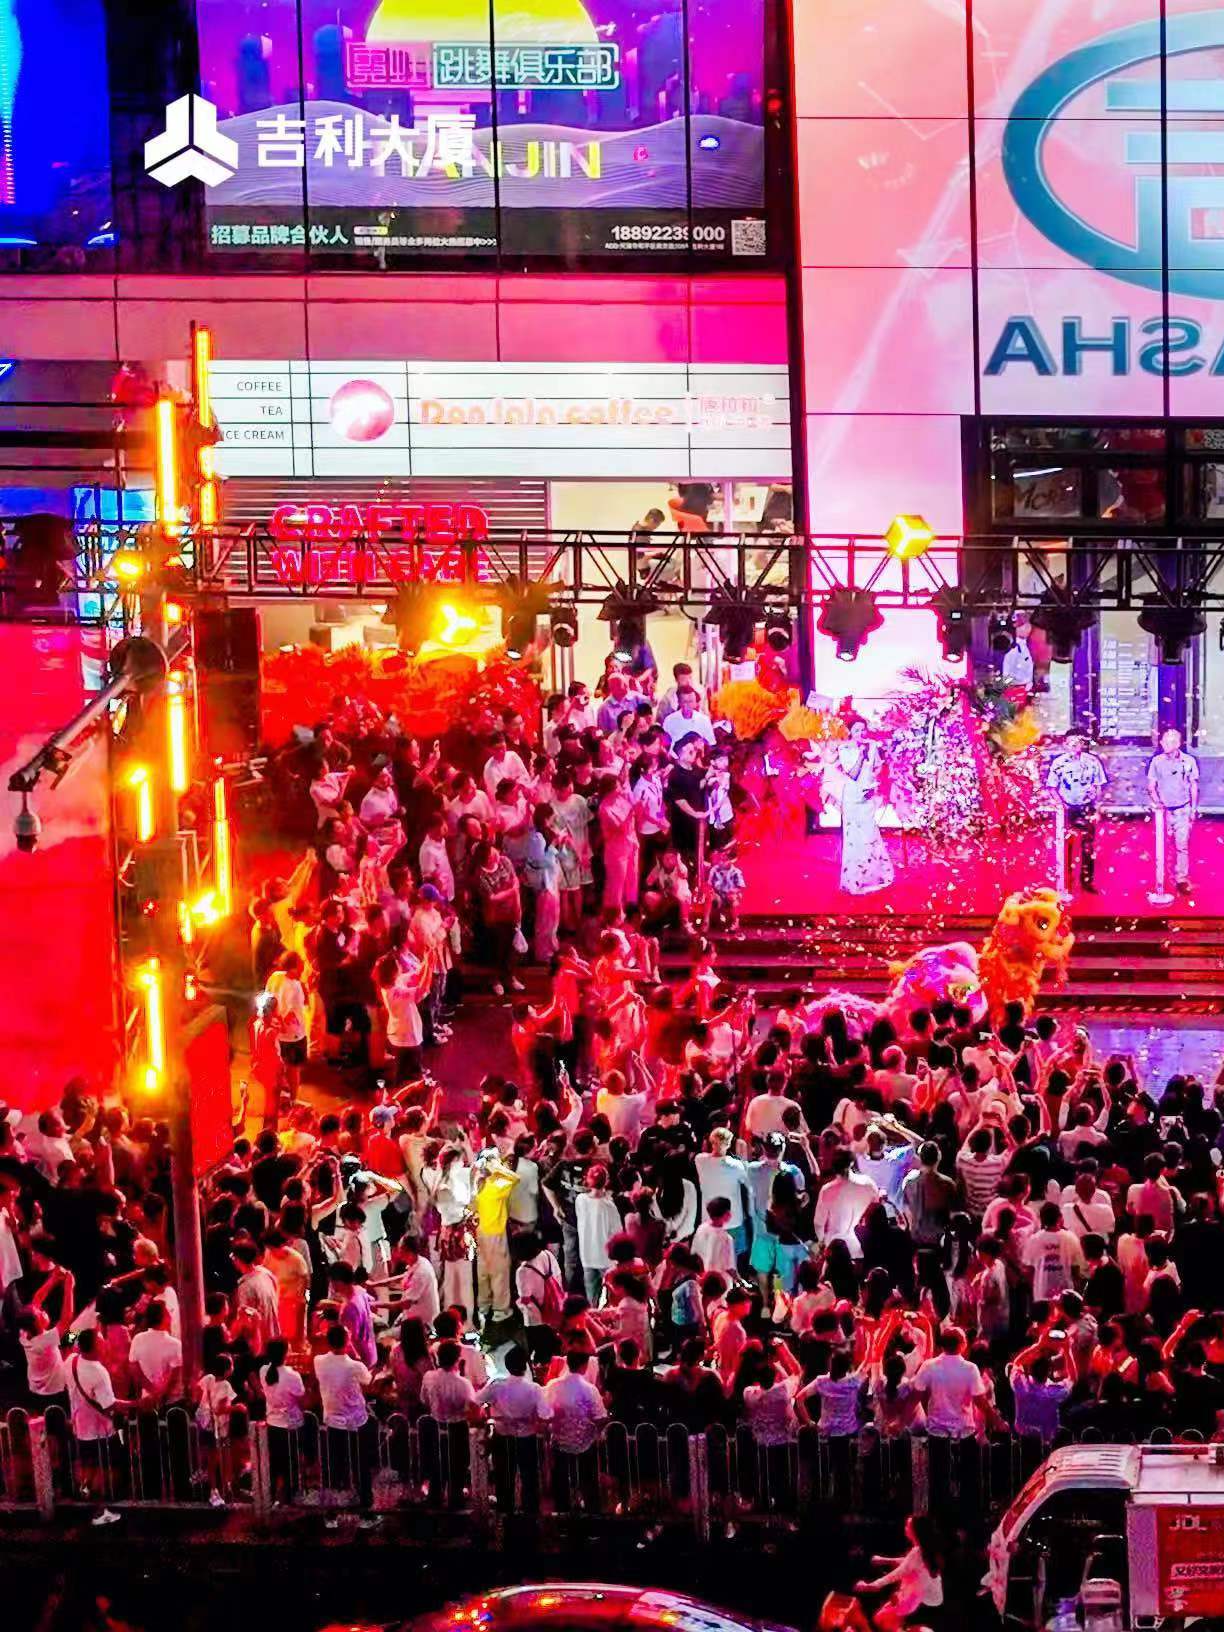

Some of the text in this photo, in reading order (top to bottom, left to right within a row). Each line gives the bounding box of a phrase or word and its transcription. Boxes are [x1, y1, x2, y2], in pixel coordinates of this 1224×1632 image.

[439, 48, 614, 84] 跳舞俱乐部
[211, 225, 348, 244] 招募品牌合伙人
[237, 381, 283, 392] COFFEE
[260, 405, 283, 416] TEA
[222, 430, 285, 440] CE CREAM
[271, 504, 489, 541] CRAFTED
[1169, 1515, 1207, 1531] JDL
